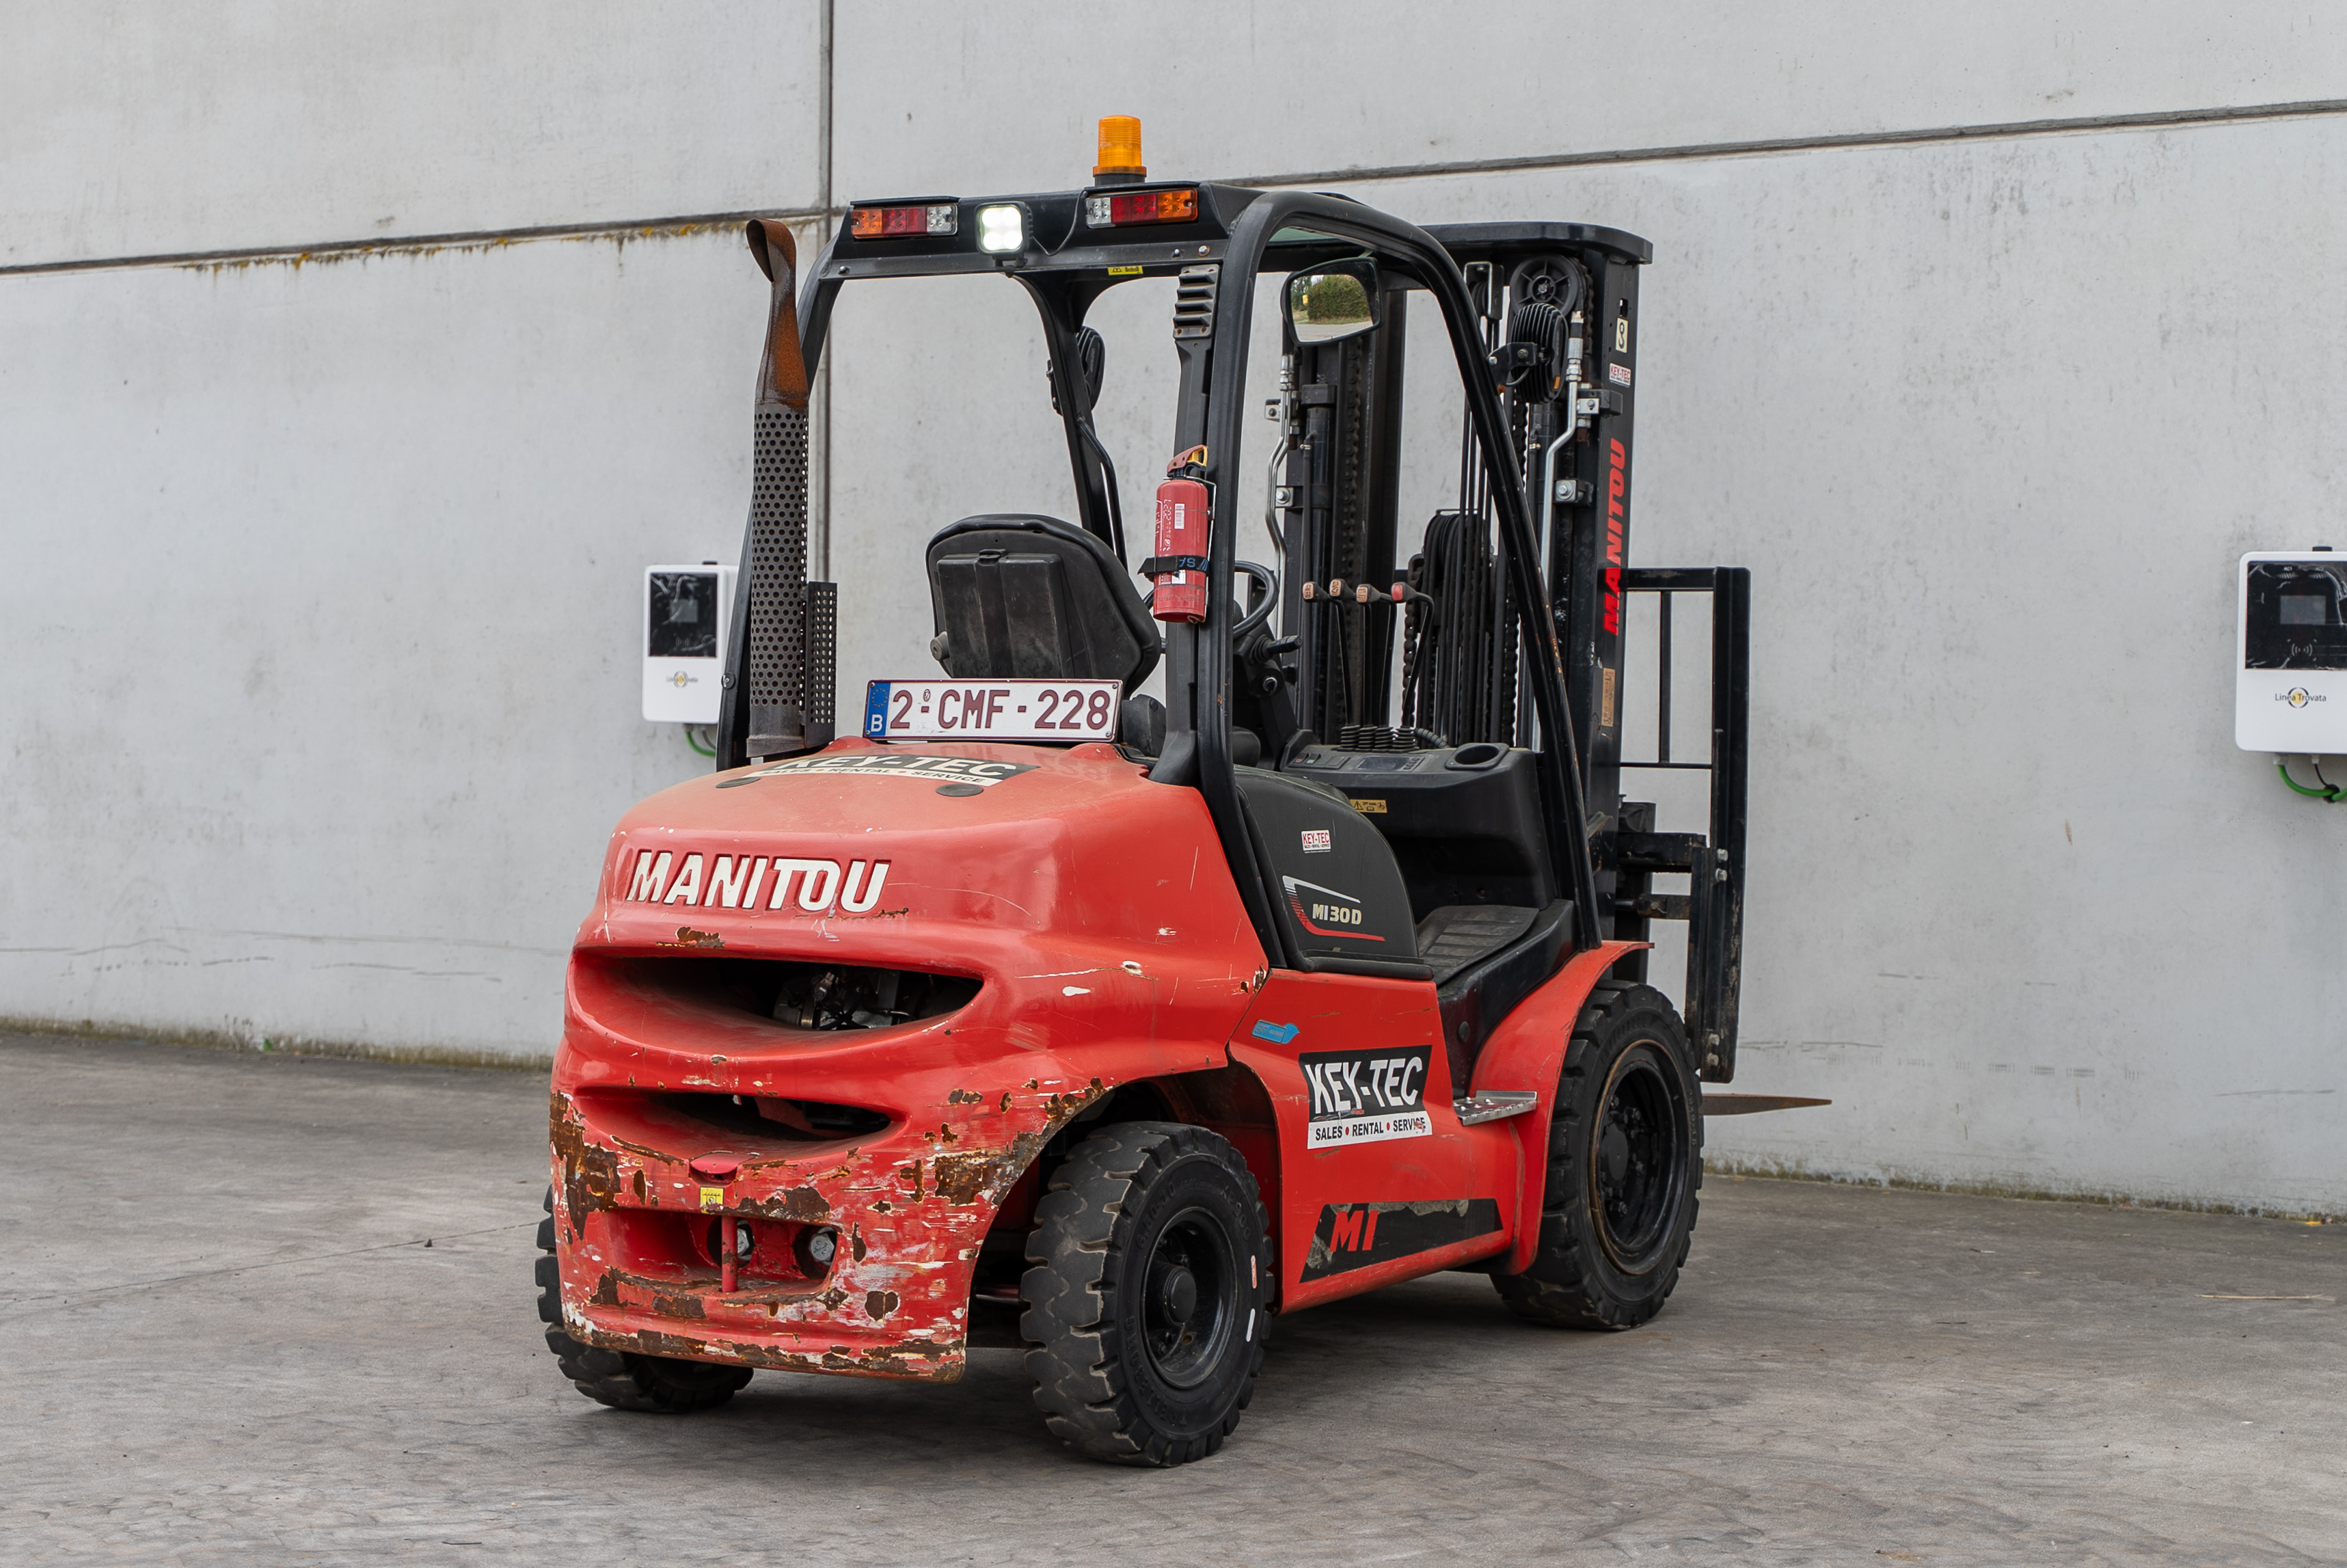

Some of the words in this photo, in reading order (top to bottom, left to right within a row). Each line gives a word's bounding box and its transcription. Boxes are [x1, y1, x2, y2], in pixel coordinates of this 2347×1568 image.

[1603, 437, 1625, 636] MANITOU
[2275, 693, 2296, 701] Linea
[871, 714, 883, 732] B
[774, 756, 1017, 776] KEY-TEC
[911, 771, 986, 783] SERVICE
[1303, 833, 1329, 845] KEY-TEC
[627, 851, 890, 913] MANITOU
[1305, 1057, 1423, 1114] KEY-TEC
[1315, 1126, 1343, 1141] SALES
[1352, 1122, 1384, 1137] RENTAL
[1329, 1210, 1379, 1252] MI
